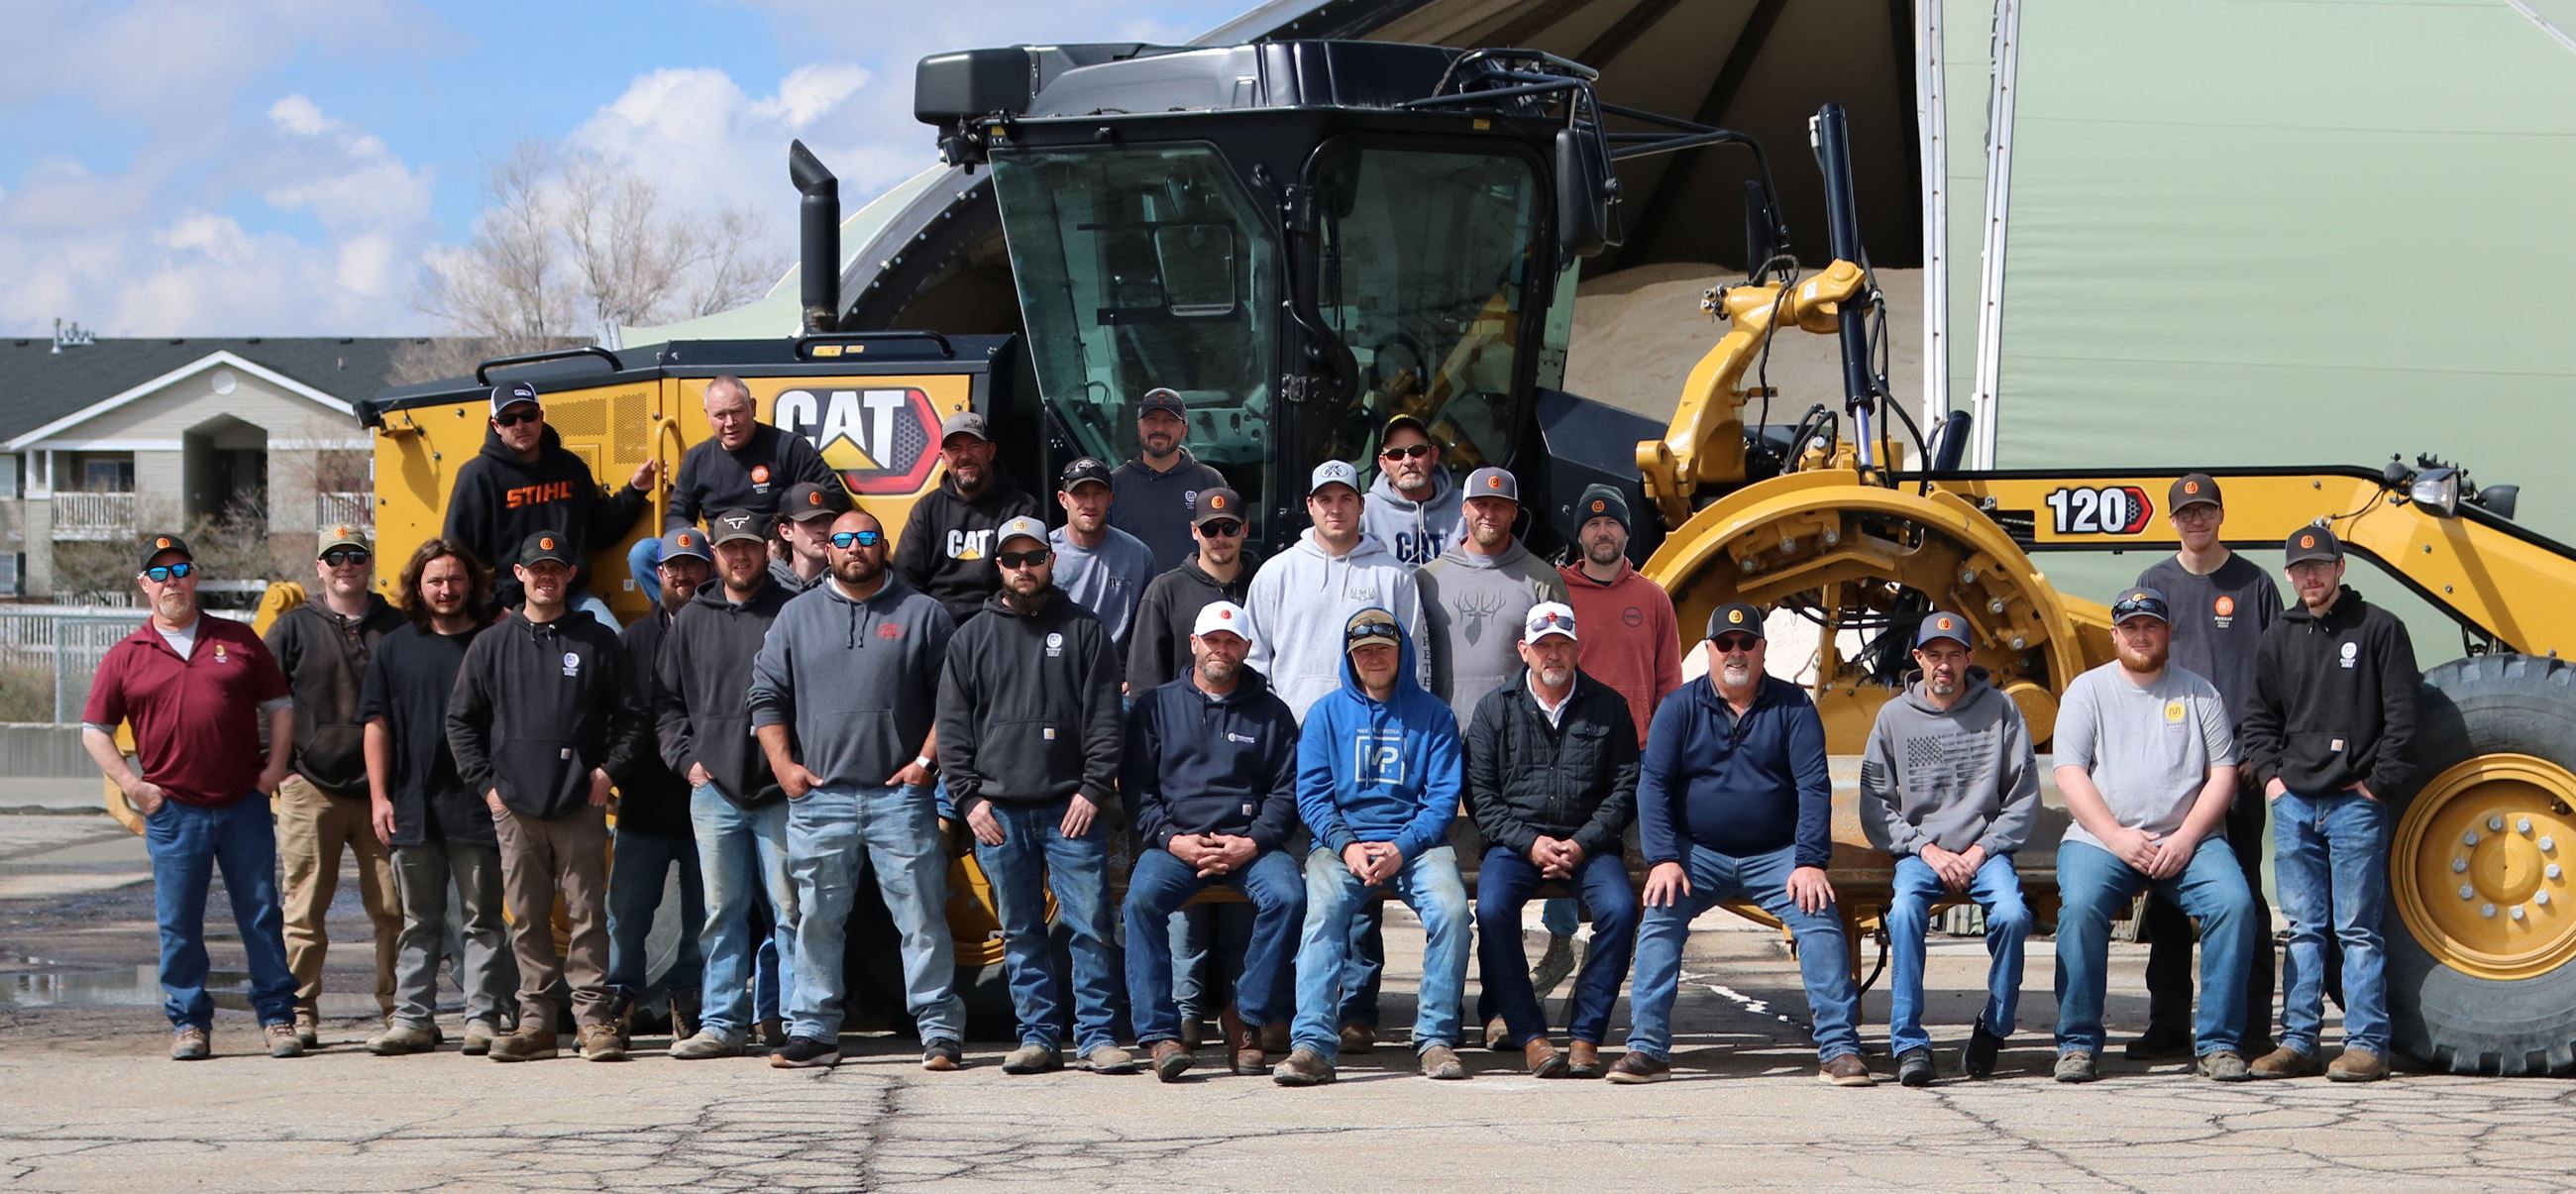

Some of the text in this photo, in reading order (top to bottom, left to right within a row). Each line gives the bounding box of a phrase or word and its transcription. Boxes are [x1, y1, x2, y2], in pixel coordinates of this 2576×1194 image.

[776, 390, 905, 469] CAT
[505, 481, 572, 509] STIHL
[2047, 488, 2126, 532] 120
[946, 529, 991, 559] CAT
[1396, 531, 1444, 564] CAT
